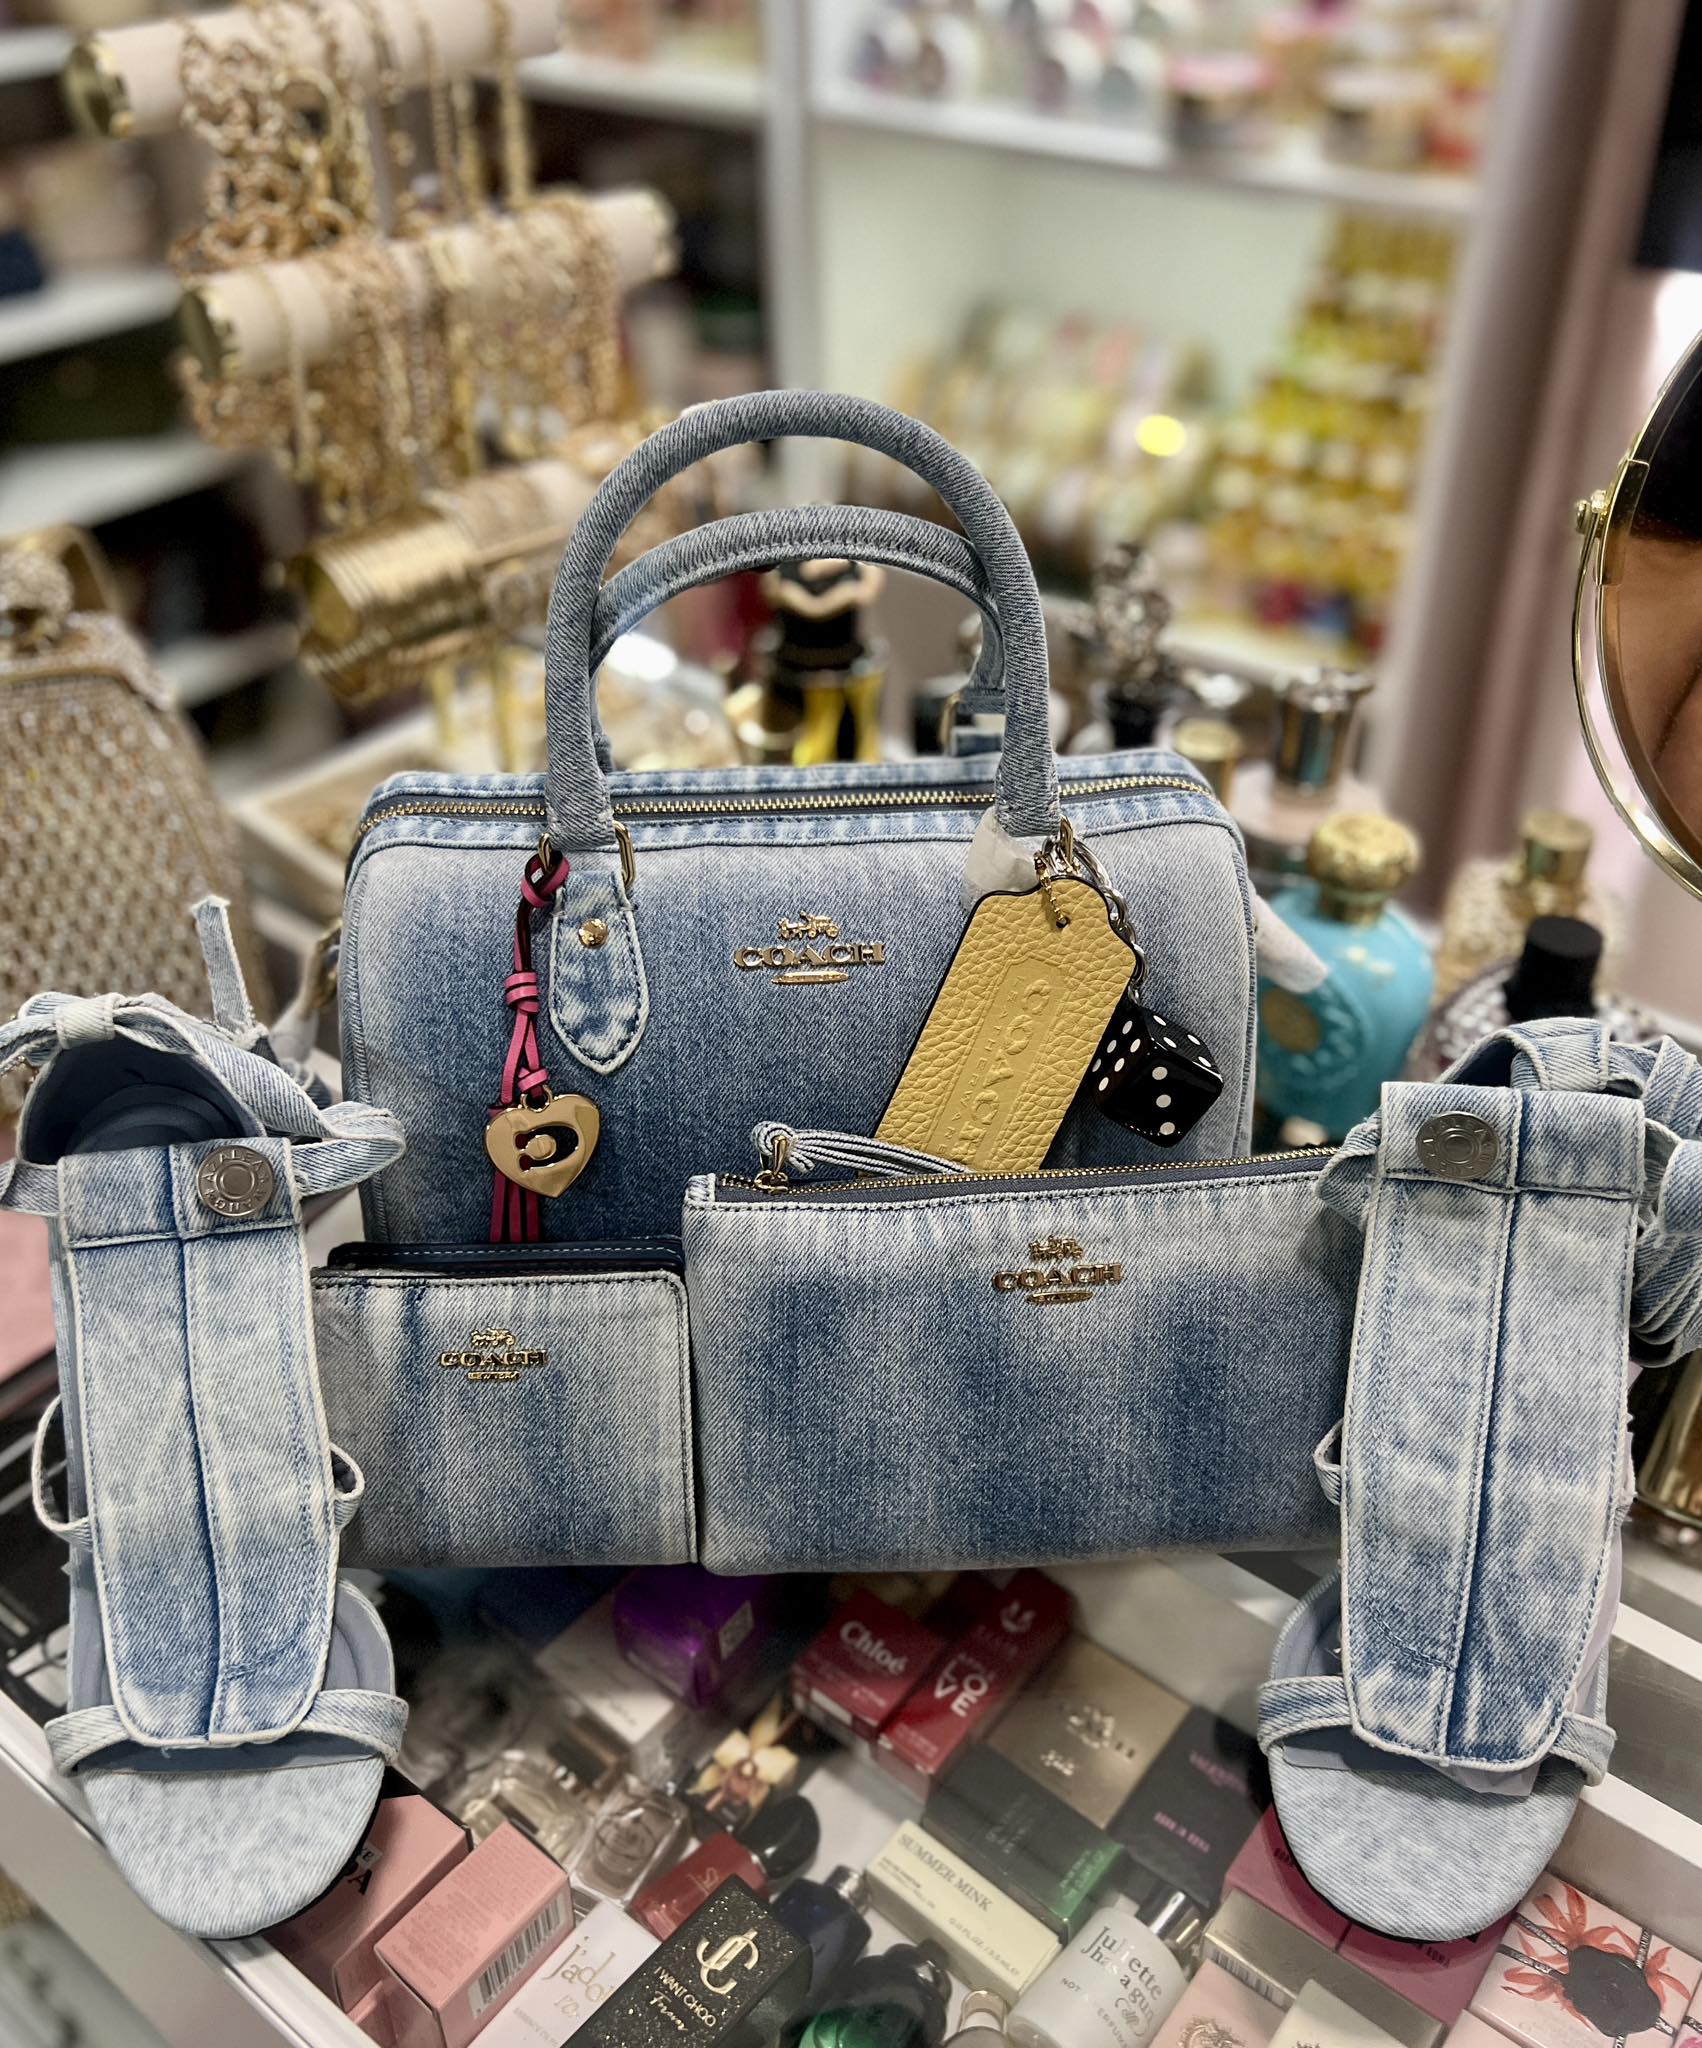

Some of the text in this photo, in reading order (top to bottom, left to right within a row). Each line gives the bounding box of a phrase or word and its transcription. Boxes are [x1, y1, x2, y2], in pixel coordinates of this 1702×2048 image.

[734, 941, 885, 968] COACH
[956, 978, 1050, 1158] COACH
[992, 1263, 1122, 1292] COACH
[441, 1348, 549, 1367] COACH
[839, 1620, 909, 1676] Chloé
[898, 1833, 956, 1884] SUMMER
[954, 1876, 993, 1912] MINK
[1062, 1977, 1082, 1992] NOT
[1081, 1926, 1162, 2001] Juliette
[653, 1965, 717, 2028] I WANT CHOO
[1120, 1974, 1131, 1989] a
[1128, 1987, 1154, 2020] gun
